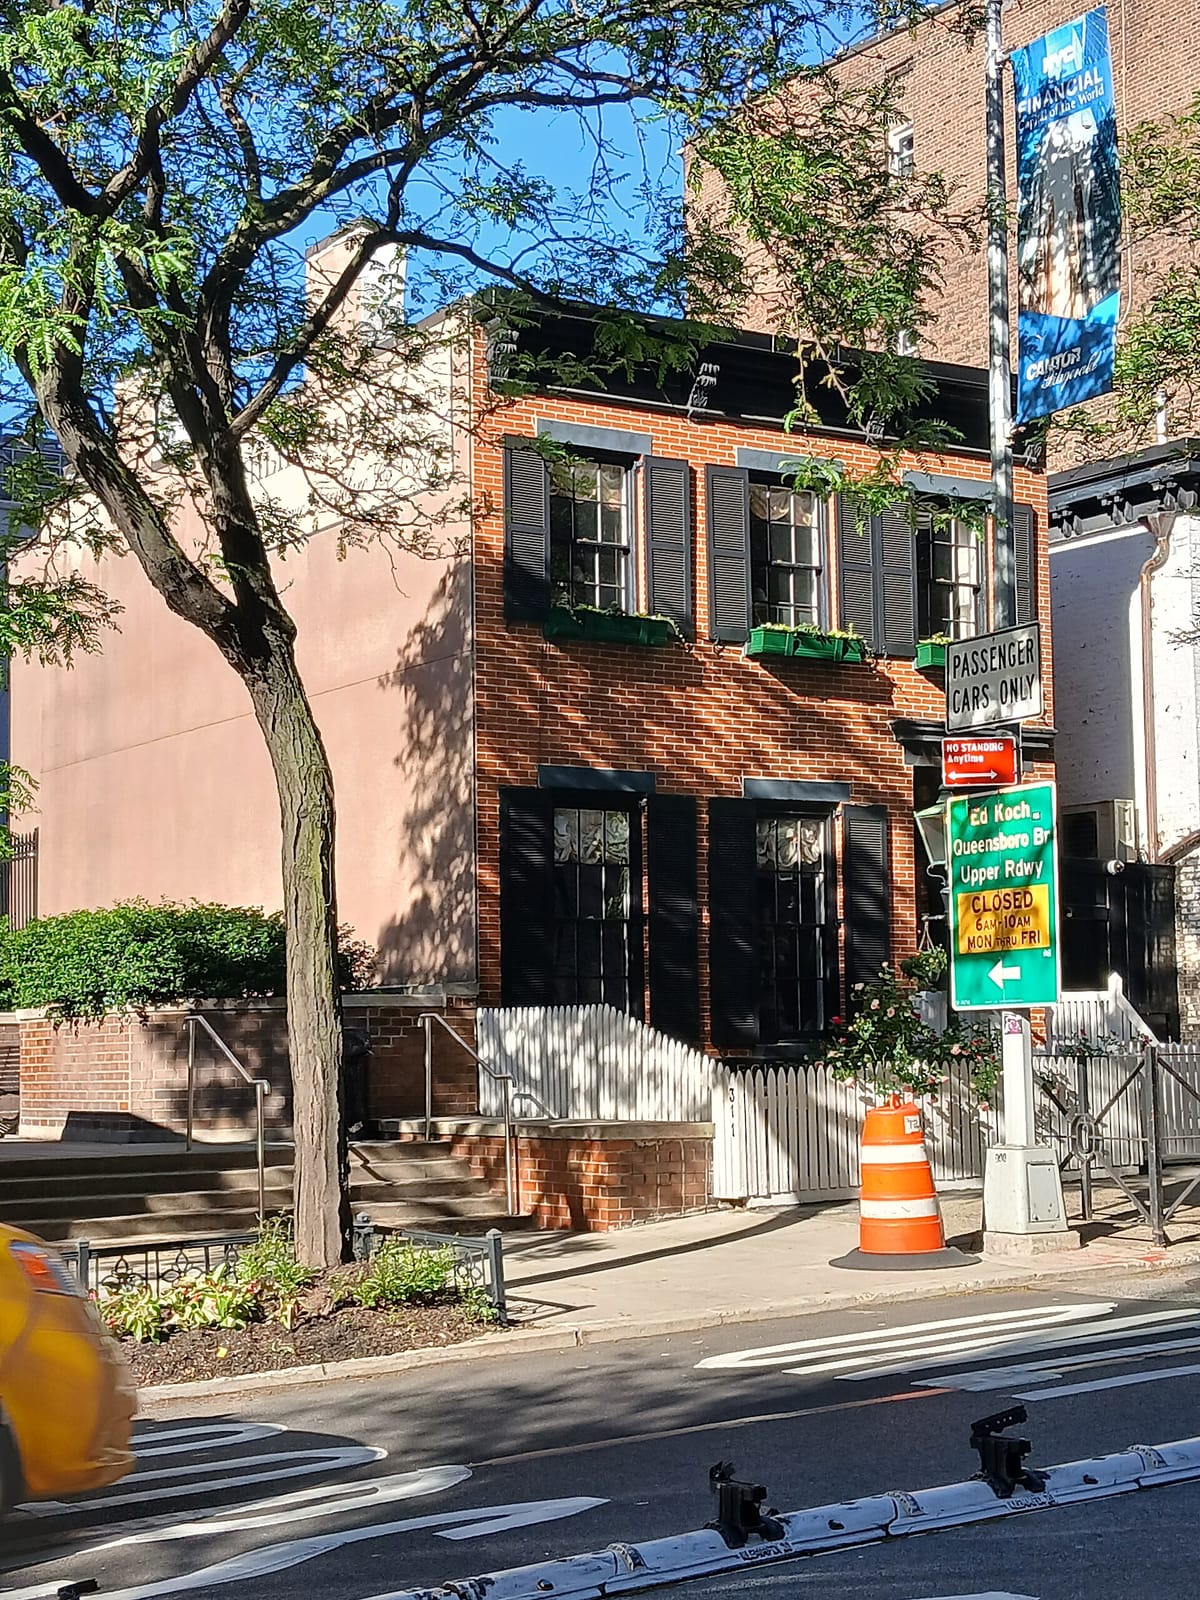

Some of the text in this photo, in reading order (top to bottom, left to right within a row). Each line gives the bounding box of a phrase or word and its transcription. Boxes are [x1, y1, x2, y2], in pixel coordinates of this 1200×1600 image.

[1017, 66, 1104, 114] FINANCIAL
[1061, 98, 1076, 113] the
[1078, 83, 1104, 105] World
[952, 637, 1035, 680] PASSENGER
[952, 673, 1035, 714] CARS ONLY
[946, 742, 1004, 753] NO STANDING
[947, 754, 984, 764] Anytime
[970, 807, 988, 826] Ed
[953, 827, 1051, 857] Queensboro Br
[960, 859, 1044, 886] Upper Rdwy
[971, 890, 1034, 914] CLOSED
[967, 930, 1041, 950] MON THRU FRI
